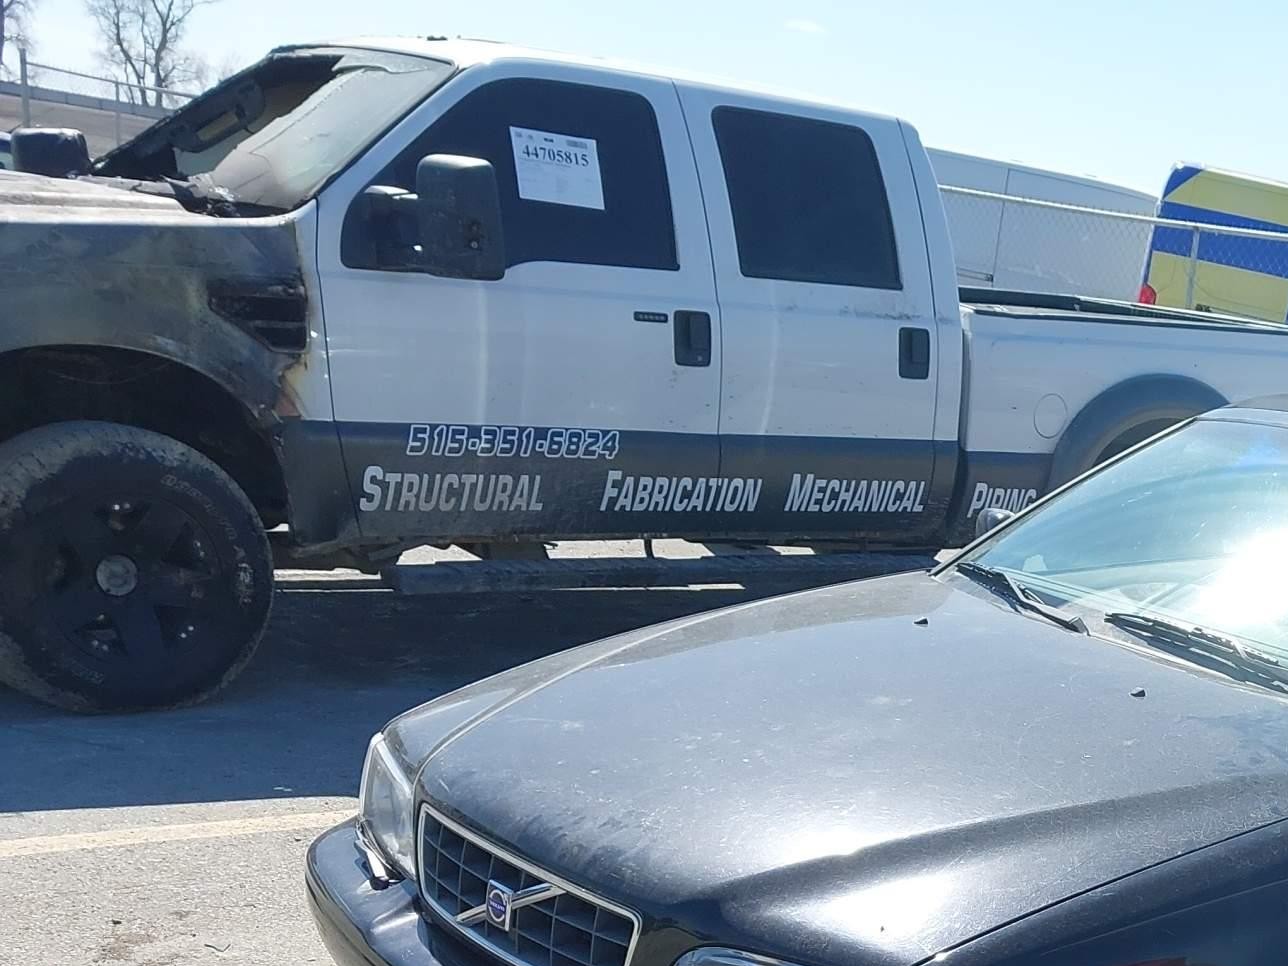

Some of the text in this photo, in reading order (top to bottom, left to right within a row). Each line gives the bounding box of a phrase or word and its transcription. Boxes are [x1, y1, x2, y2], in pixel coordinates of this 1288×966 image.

[522, 145, 589, 167] 44705815
[406, 424, 619, 459] 515-351-6824
[359, 465, 543, 512] STRUCTURAL
[600, 469, 762, 512] FABRICATION
[784, 473, 925, 513] MECHANICAL
